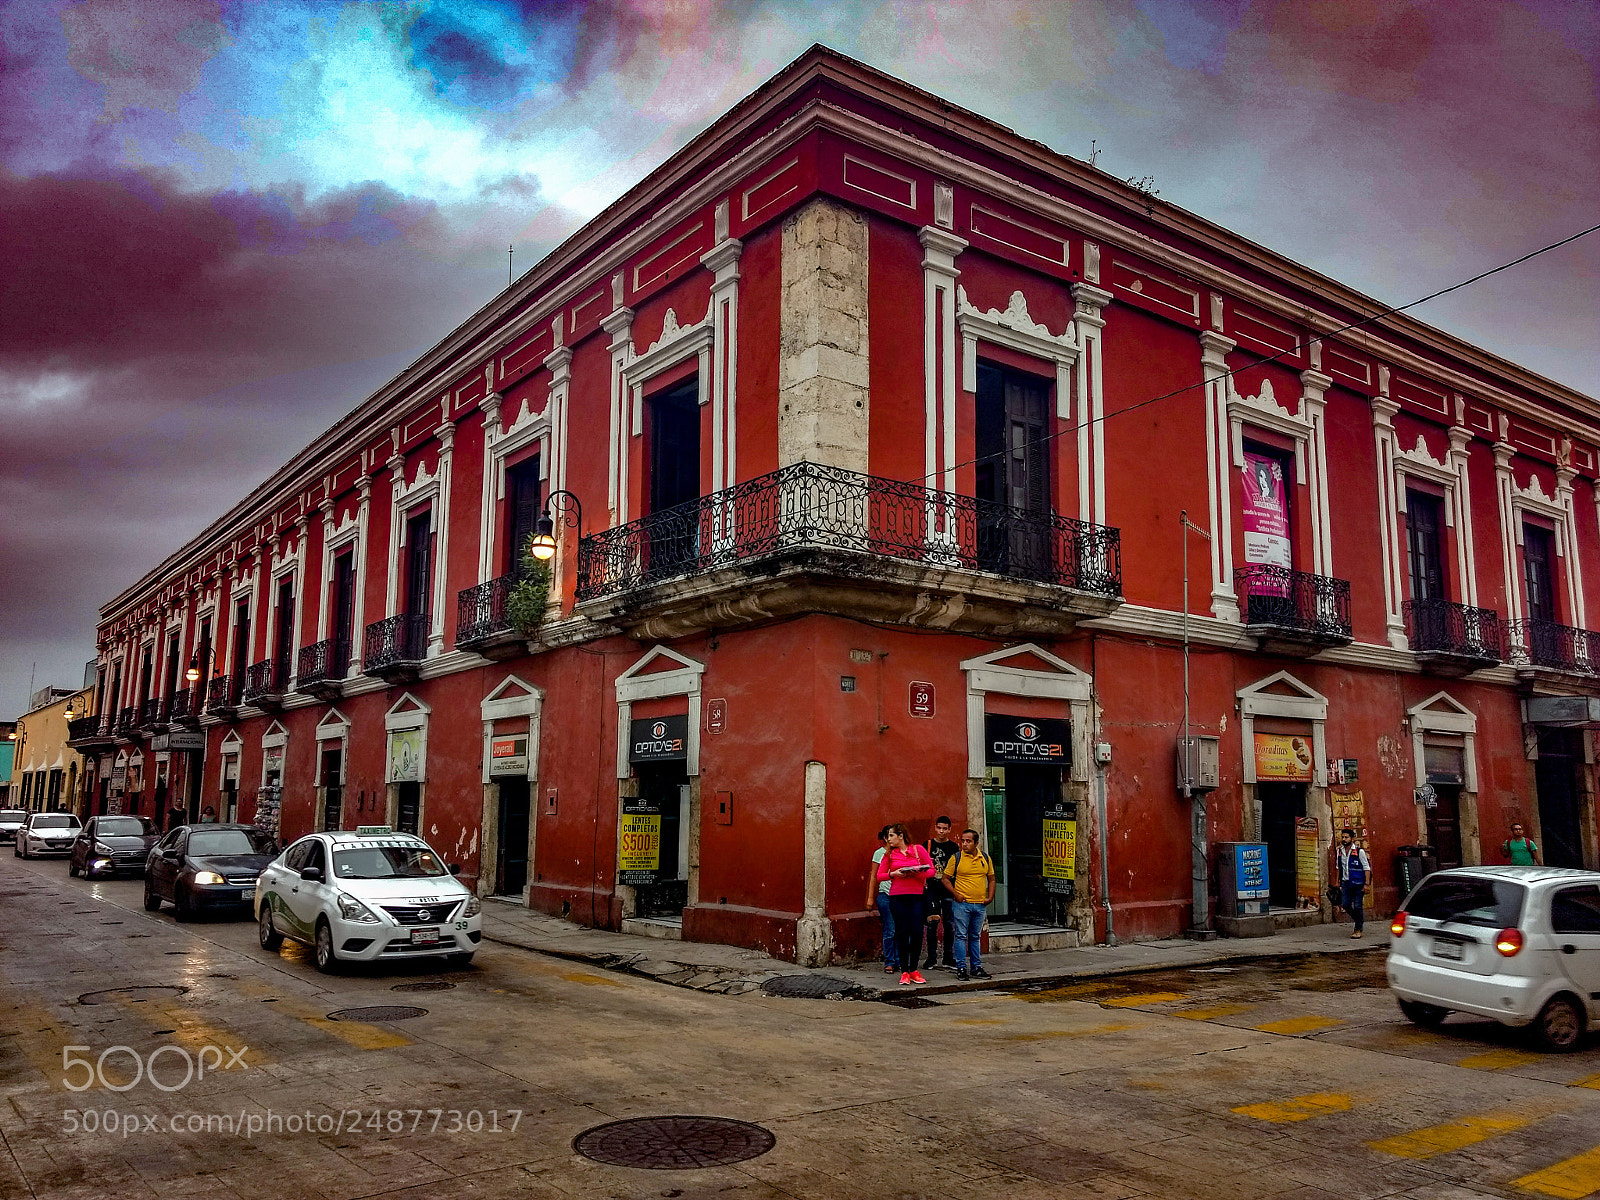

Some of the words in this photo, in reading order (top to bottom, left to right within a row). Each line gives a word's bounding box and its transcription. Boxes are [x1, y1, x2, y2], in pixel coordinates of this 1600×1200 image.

[916, 693, 929, 704] 59
[712, 709, 721, 720] 58
[623, 824, 658, 833] COMPLETOS
[623, 833, 651, 852] $500
[1044, 838, 1067, 859] $500
[455, 920, 468, 931] 39
